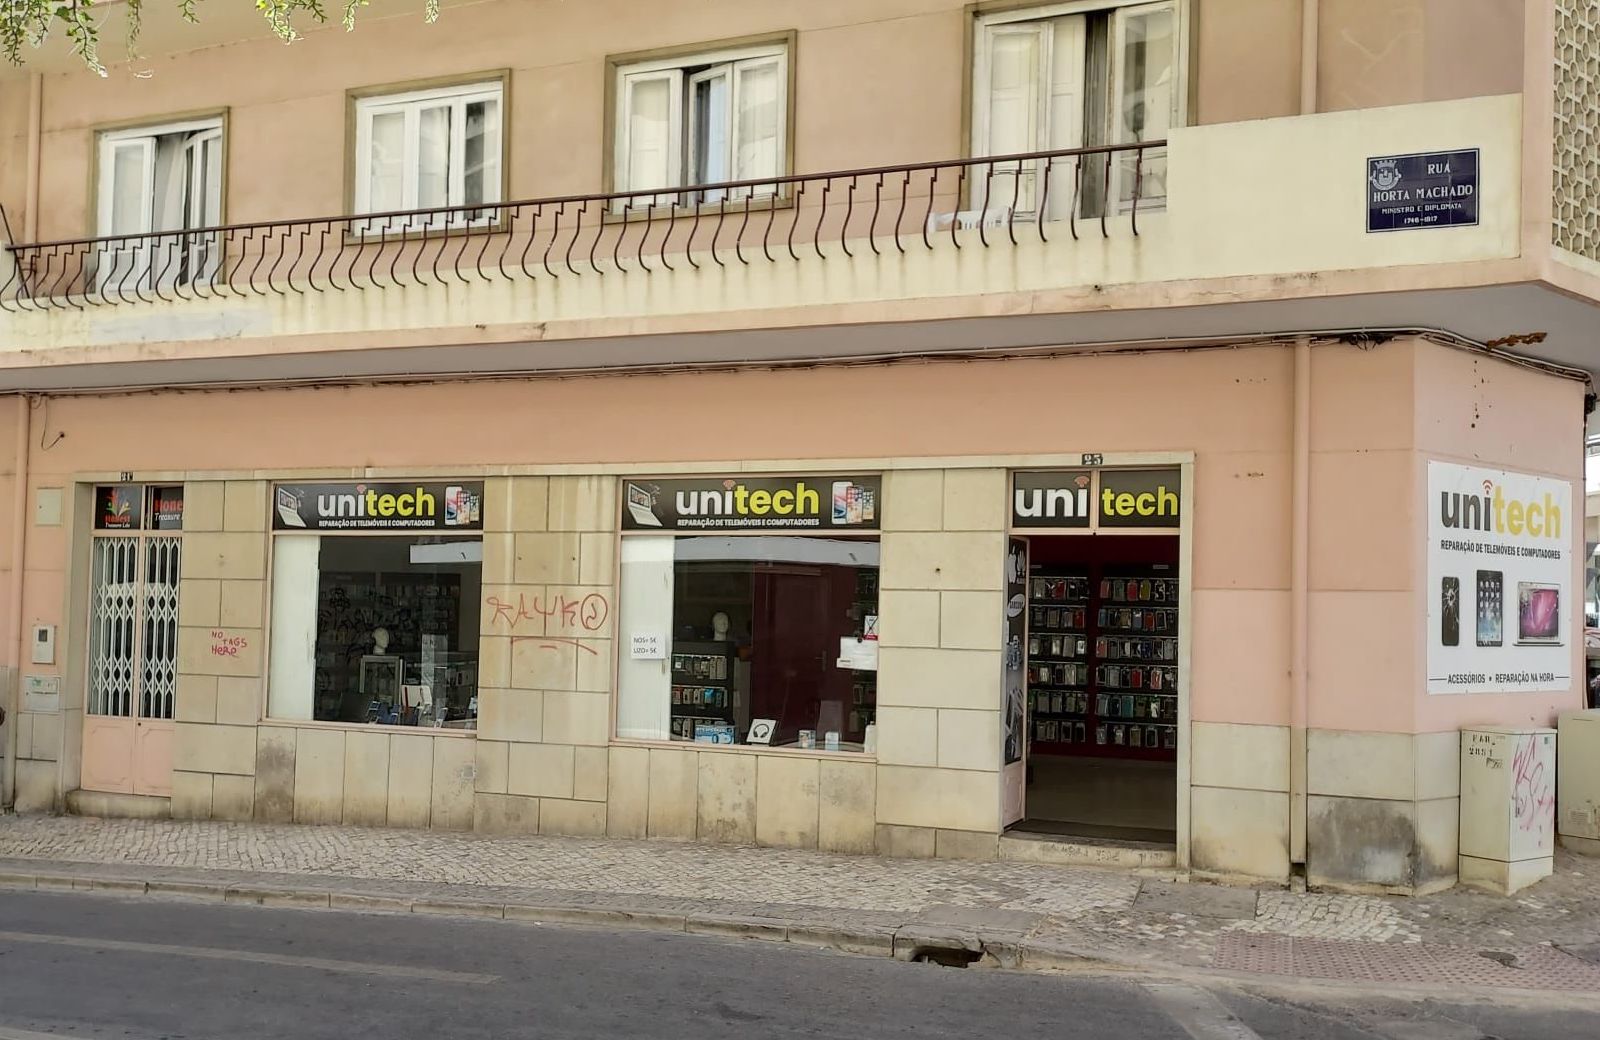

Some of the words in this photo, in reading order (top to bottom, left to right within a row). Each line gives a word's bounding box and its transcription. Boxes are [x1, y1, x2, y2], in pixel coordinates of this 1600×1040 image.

[1427, 162, 1451, 175] RUA
[1373, 190, 1410, 202] HORTA
[1416, 184, 1473, 199] MACHADO
[1381, 206, 1415, 214] MINISTRO
[1424, 202, 1462, 211] DIPLOMATA
[317, 484, 435, 517] unitech
[675, 480, 819, 515] unitech
[1441, 480, 1561, 539] unitech
[318, 519, 349, 528] REPARAÇÃO
[358, 519, 387, 527] TELEMÓVEIS
[392, 519, 435, 527] COMPUTADORES
[677, 518, 714, 528] REPARAÇÃO
[725, 518, 761, 526] TELEMÓVEIS
[767, 518, 819, 526] COMPUTADORES
[1440, 540, 1474, 554] REPARAÇÃO
[1475, 543, 1484, 553] DE
[1484, 543, 1515, 556] TELEMÓVEIS
[1516, 547, 1520, 556] E
[1521, 547, 1561, 560] COMPUTADORES
[211, 631, 223, 639] NO
[223, 637, 247, 648] TAGS
[1448, 672, 1485, 684] ACESSÓRIOS
[1495, 671, 1529, 685] REPARAÇÃO
[1530, 673, 1539, 683] NA
[1539, 673, 1555, 682] HORA
